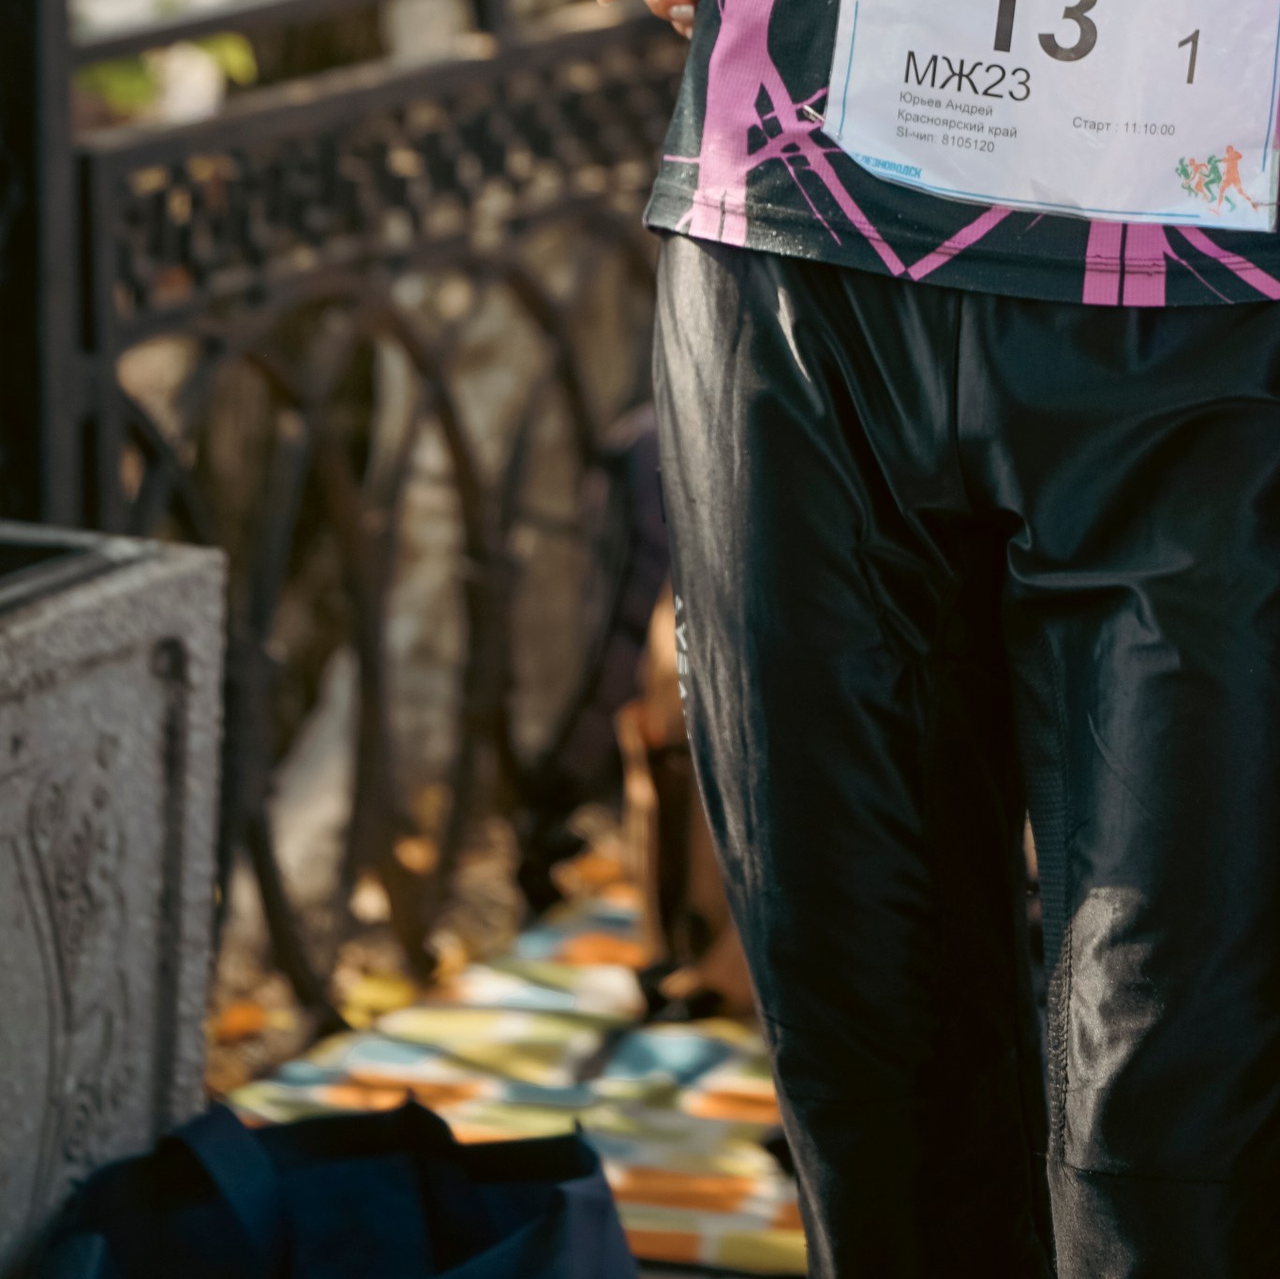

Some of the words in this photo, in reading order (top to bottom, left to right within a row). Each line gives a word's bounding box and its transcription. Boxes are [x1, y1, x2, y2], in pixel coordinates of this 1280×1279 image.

[1178, 29, 1200, 84] 1
[904, 50, 1031, 102] МЖ23
[899, 91, 942, 109] Юрьев
[945, 100, 993, 117] Андрей
[897, 109, 984, 134] Красноярский
[988, 125, 1017, 139] край
[1072, 116, 1111, 133] Старт
[1124, 122, 1175, 136] 11:10:00
[941, 133, 995, 153] 8105120
